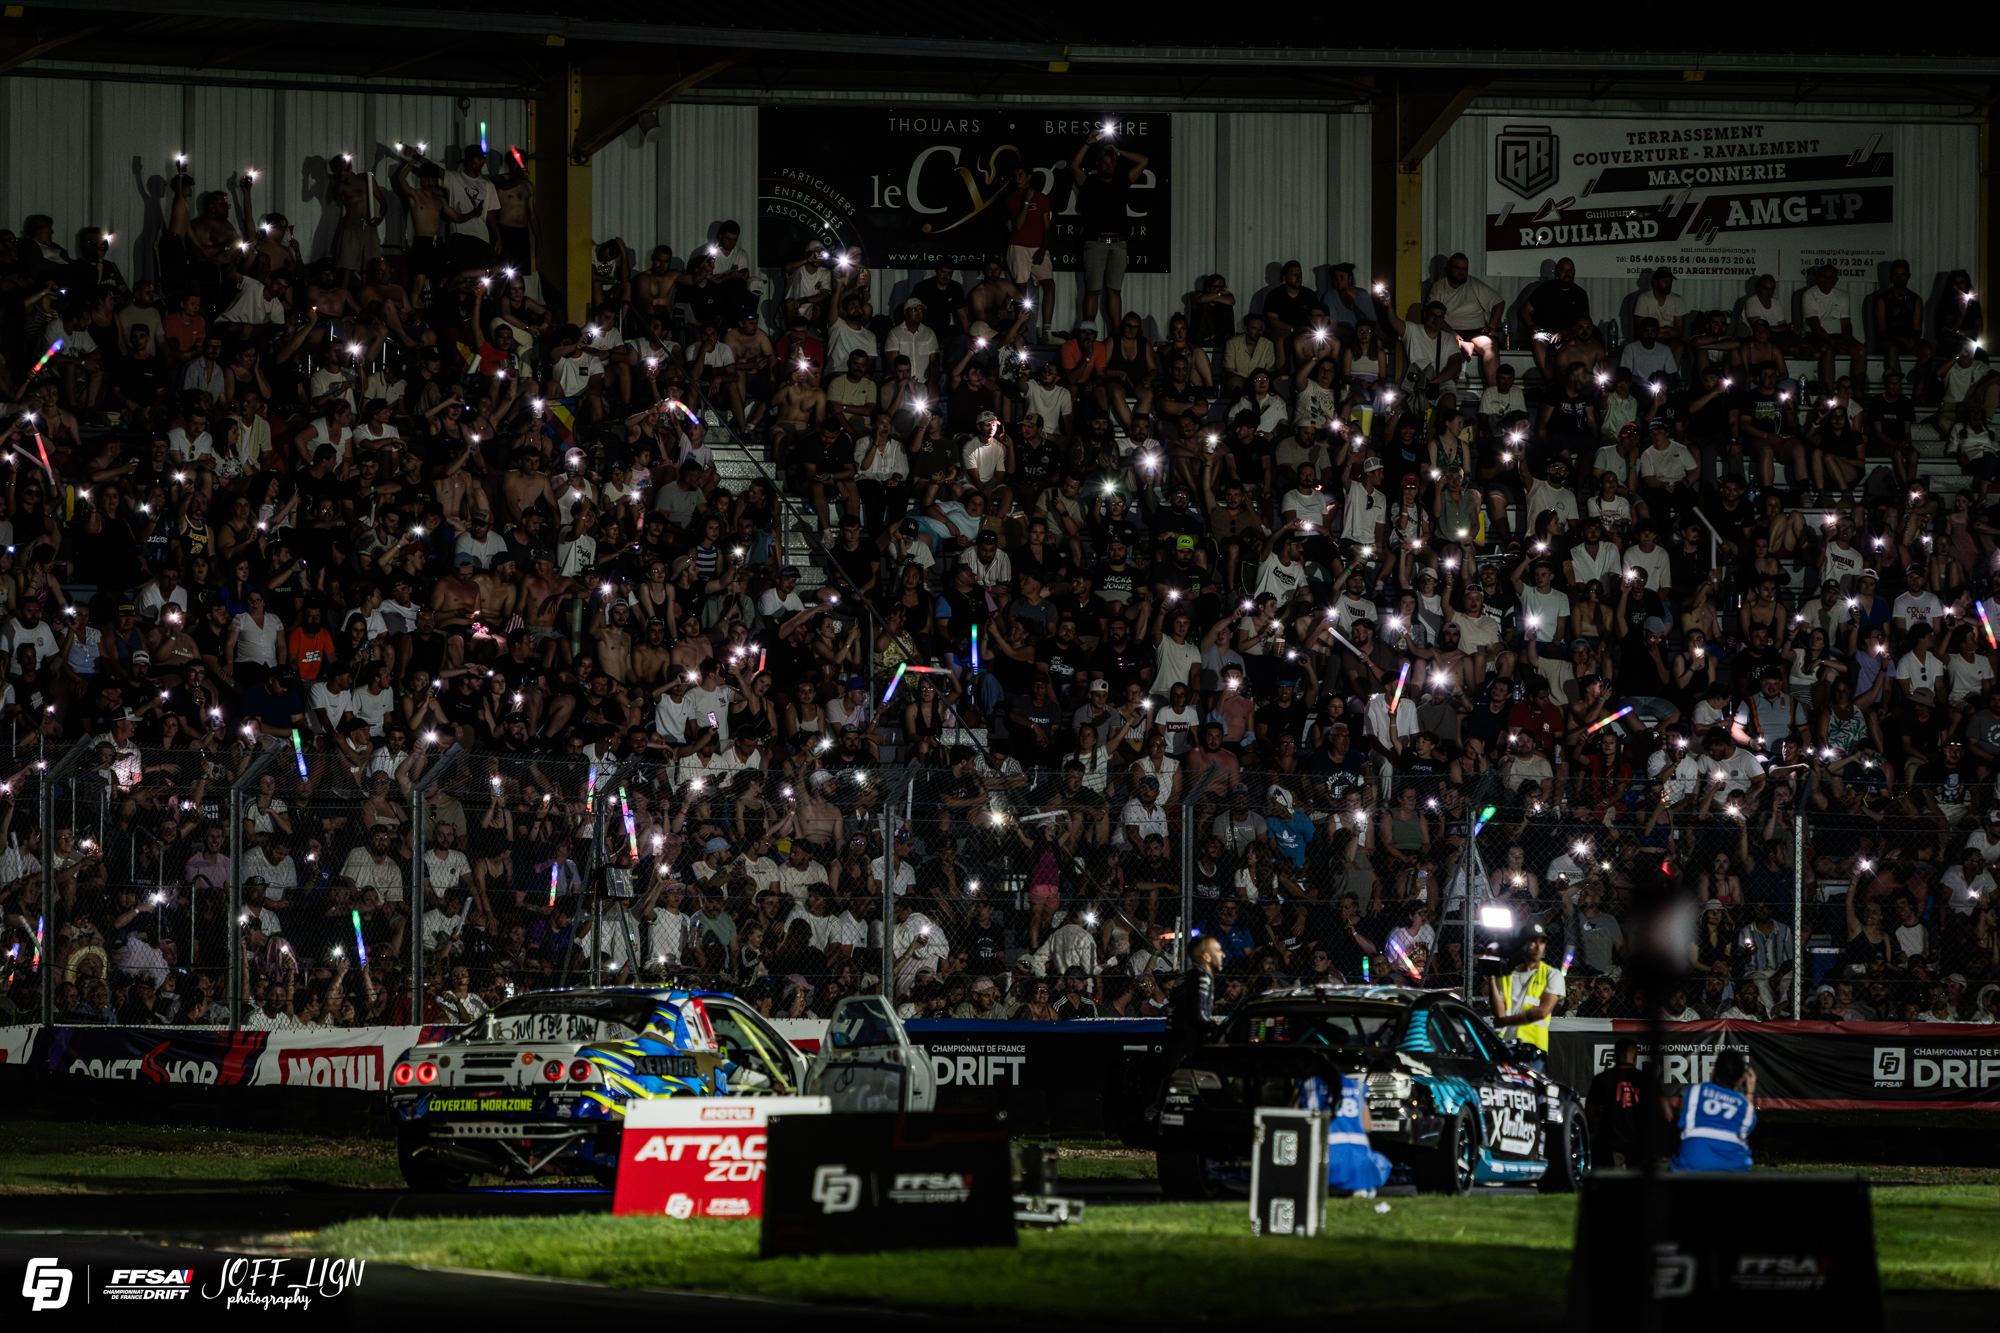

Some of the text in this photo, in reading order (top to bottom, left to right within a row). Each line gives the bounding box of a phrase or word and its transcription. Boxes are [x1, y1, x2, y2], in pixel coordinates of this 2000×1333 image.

[889, 118, 1148, 135] THOUARS BRESSIRE
[1627, 125, 1764, 145] TERRASSEMENT
[1573, 148, 1689, 166] COUVERTURE
[1703, 140, 1820, 158] RAVALEMENT
[1648, 163, 1787, 188] MAÇONNERIE
[782, 168, 855, 217] PARTICULIERS
[774, 186, 844, 230] ENTREPRISES
[1725, 193, 1864, 227] AMG-TP
[766, 205, 834, 246] ASSOCIATIO
[1519, 219, 1660, 247] ROUILLARD
[1630, 255, 1641, 263] 05
[1642, 255, 1653, 263] 49
[1655, 255, 1665, 264] 65
[1667, 256, 1678, 264] 95
[1679, 256, 1690, 264] 84
[1709, 256, 1720, 264] 80
[1721, 256, 1732, 264] 73
[1733, 256, 1744, 264] 20
[1745, 257, 1755, 265] 61
[1839, 258, 1850, 266] 73
[1851, 258, 1862, 266] 20
[1864, 258, 1873, 266] 61
[1103, 583, 1132, 591] JONES
[513, 1014, 533, 1040] JUST
[931, 1044, 1026, 1053] CHAMPIONNAT DE FRANCE
[1700, 1044, 1713, 1053] DE
[1913, 1047, 2000, 1057] CHAMPIONNAT DE F
[286, 1054, 382, 1091] MOTUL
[931, 1055, 1027, 1086] DRIFT
[1913, 1058, 2000, 1088] DRIF
[1873, 1080, 1902, 1088] FFSA
[429, 1097, 533, 1112] COVERING WORKZONE
[1480, 1086, 1537, 1112] SHIFTECH
[1702, 1100, 1739, 1120] 07
[633, 1134, 769, 1162] ATTAC
